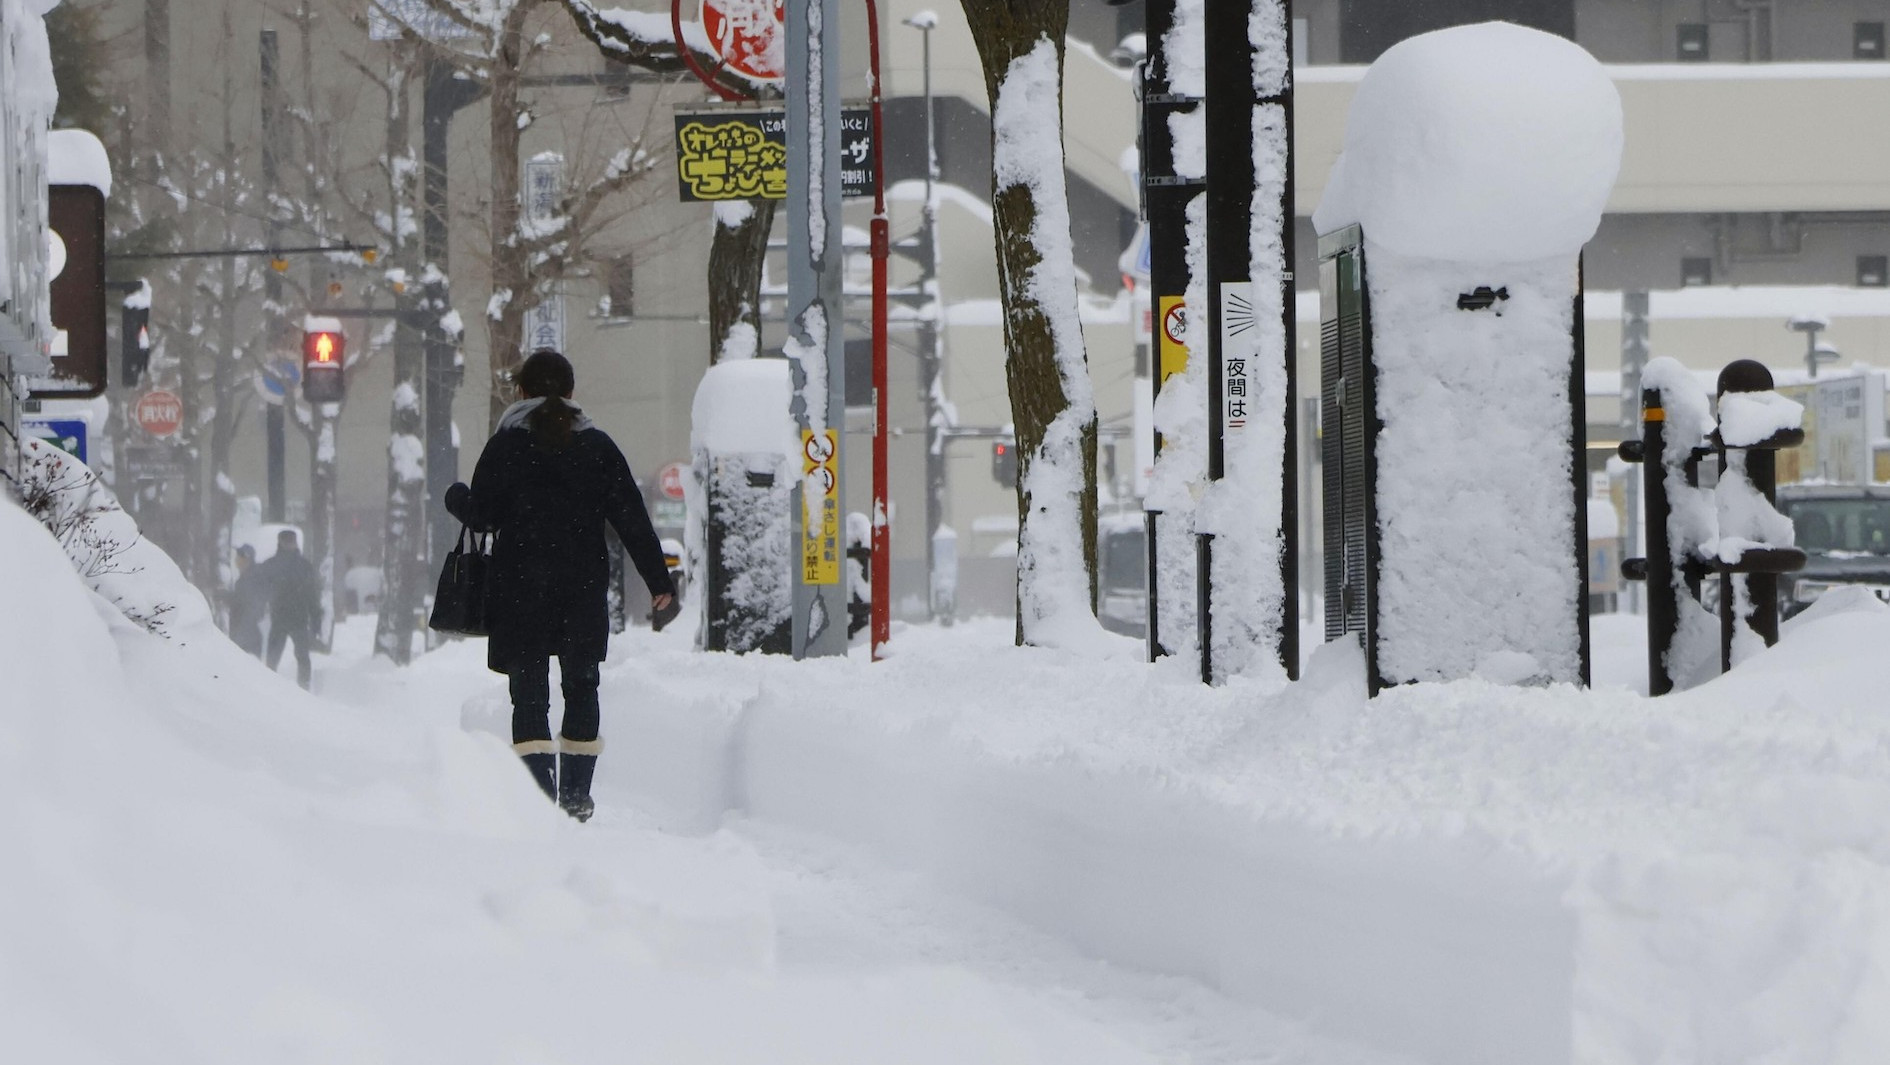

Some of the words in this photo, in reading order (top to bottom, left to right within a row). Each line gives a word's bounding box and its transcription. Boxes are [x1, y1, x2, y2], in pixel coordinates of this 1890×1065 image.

[688, 128, 757, 152] オレたちの
